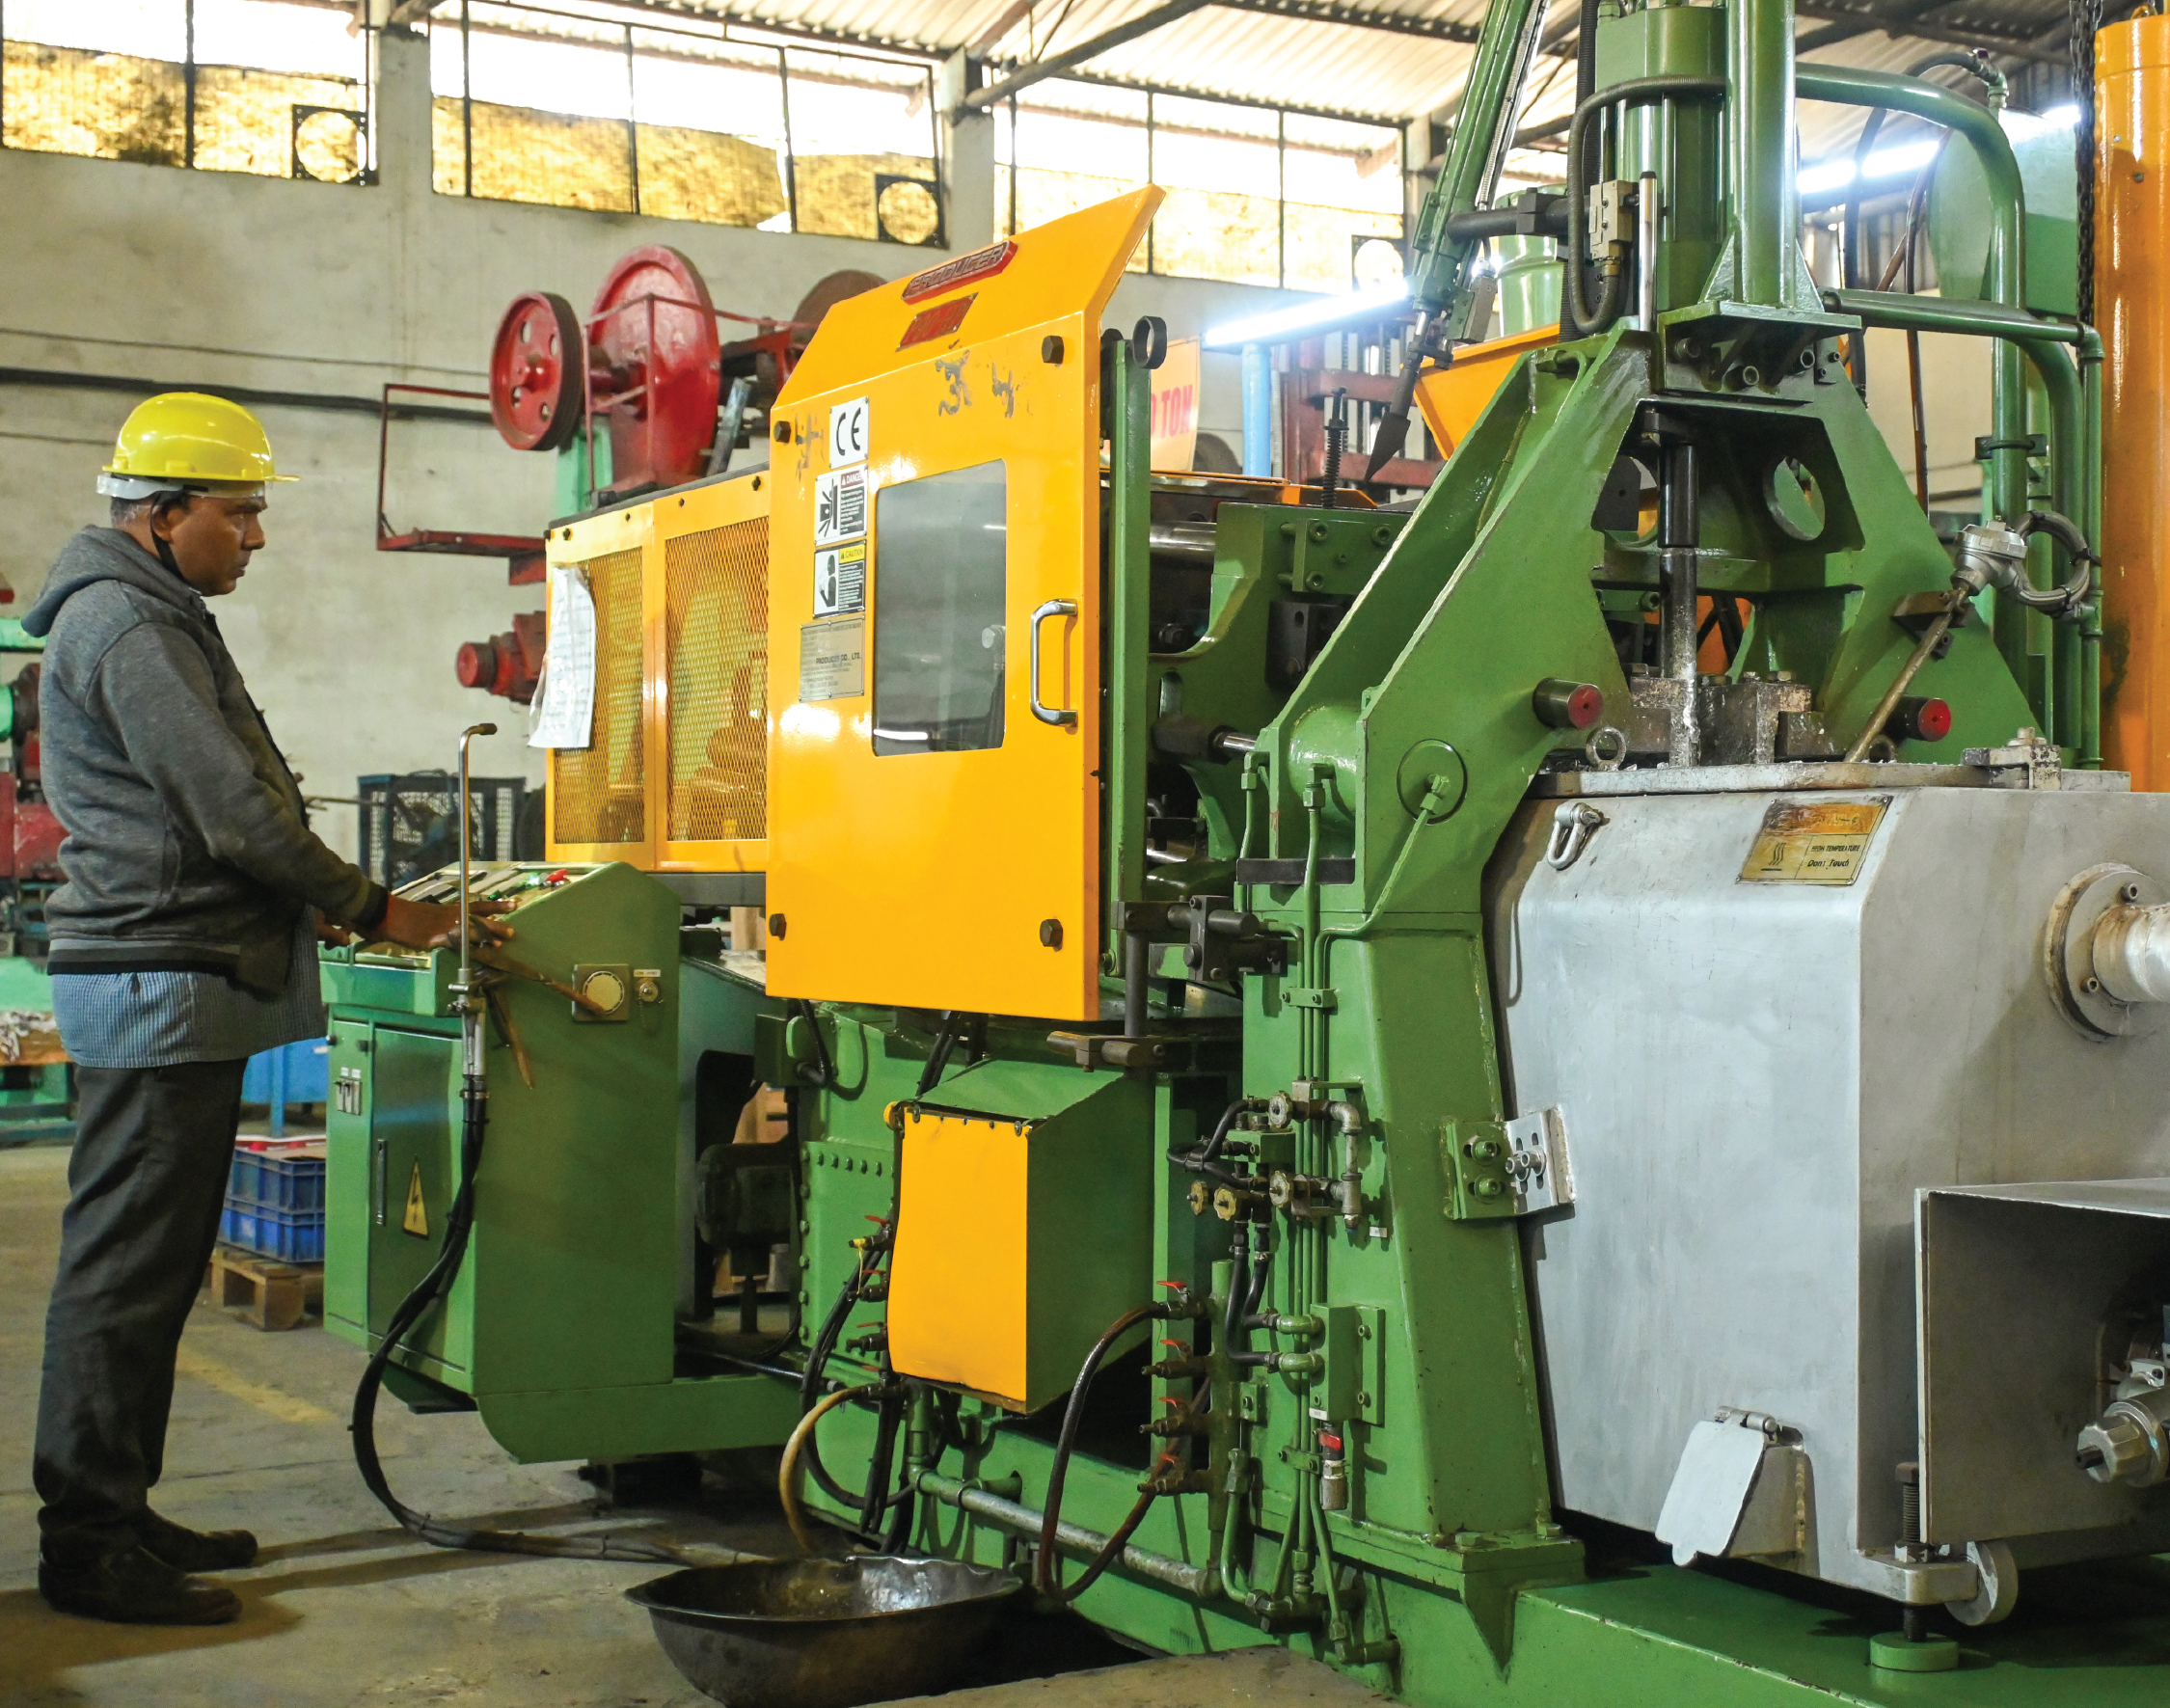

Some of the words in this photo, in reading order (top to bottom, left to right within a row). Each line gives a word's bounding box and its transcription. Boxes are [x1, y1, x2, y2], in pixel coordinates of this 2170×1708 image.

[835, 406, 861, 456] CE
[1160, 384, 1193, 439] TON
[845, 548, 863, 558] CAUTION
